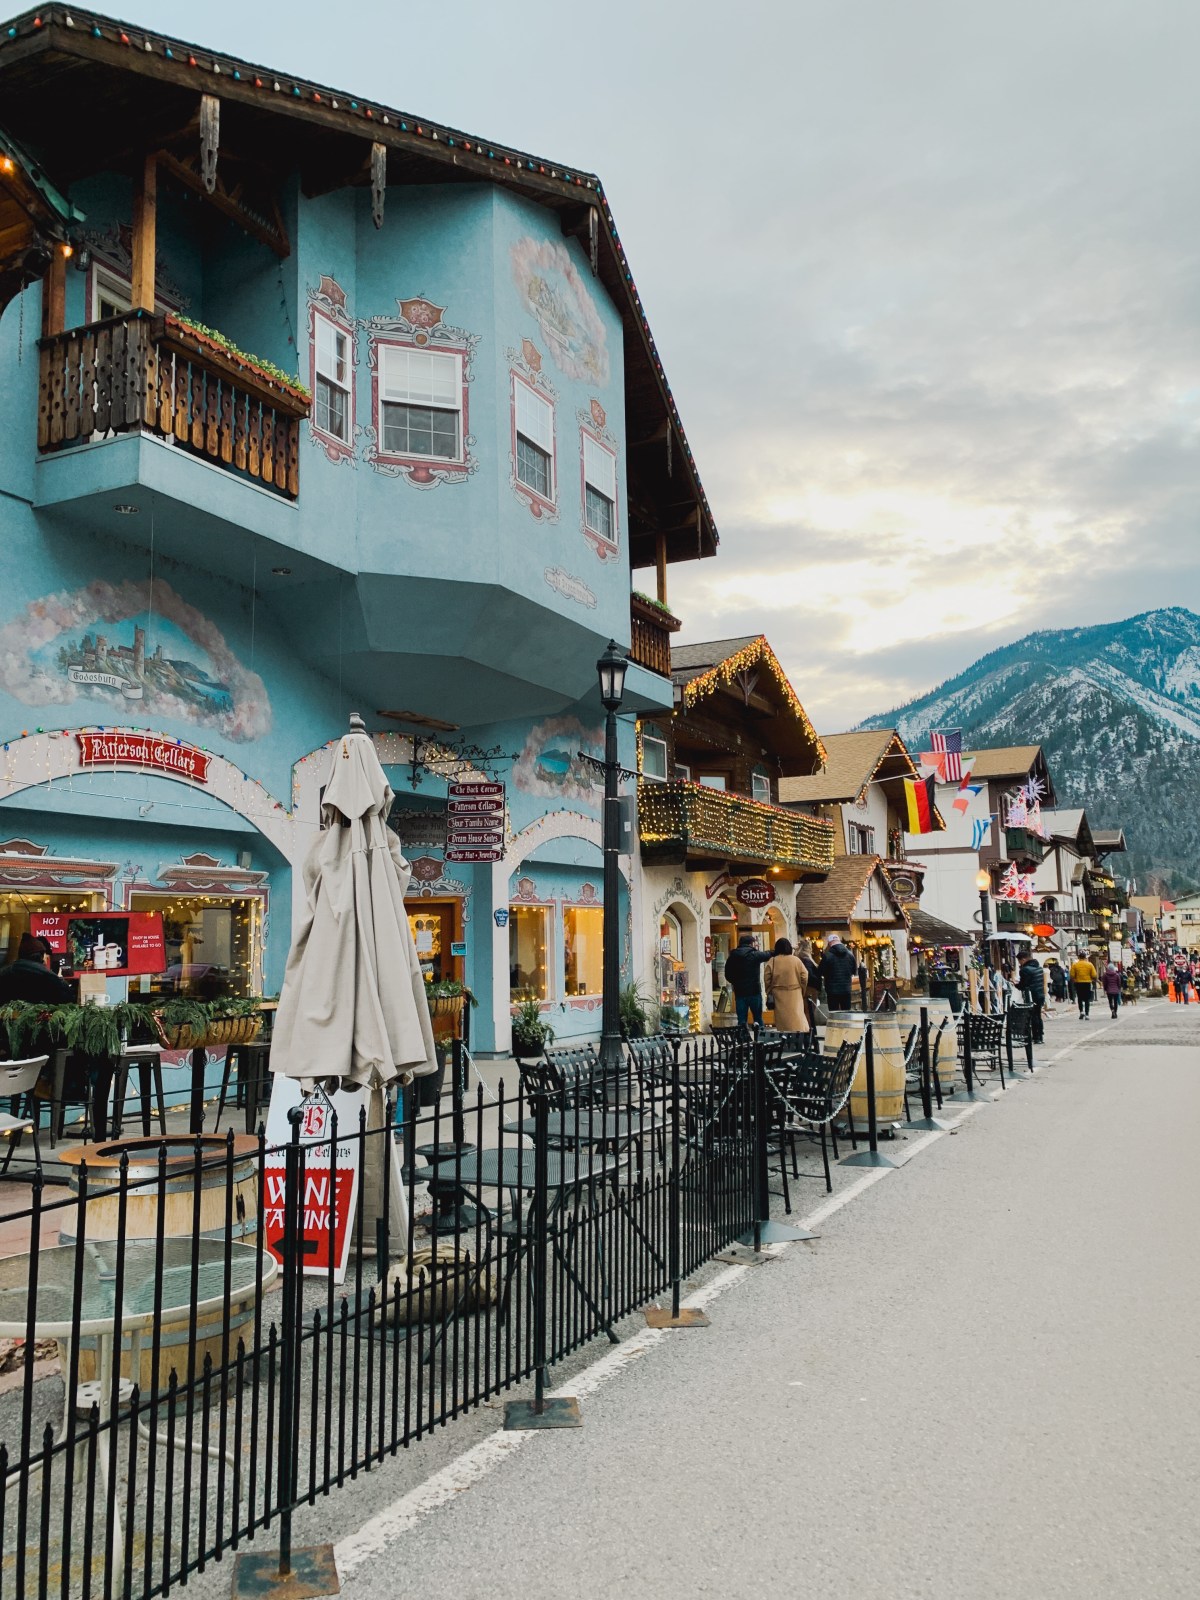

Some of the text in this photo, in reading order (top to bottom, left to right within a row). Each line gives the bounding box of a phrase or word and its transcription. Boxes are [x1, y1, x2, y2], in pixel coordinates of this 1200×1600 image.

[93, 738, 195, 771] Patterson Cellars
[741, 889, 770, 900] Shirt
[42, 917, 60, 925] HOT
[36, 929, 65, 937] MULLED
[266, 1175, 342, 1207] WNE
